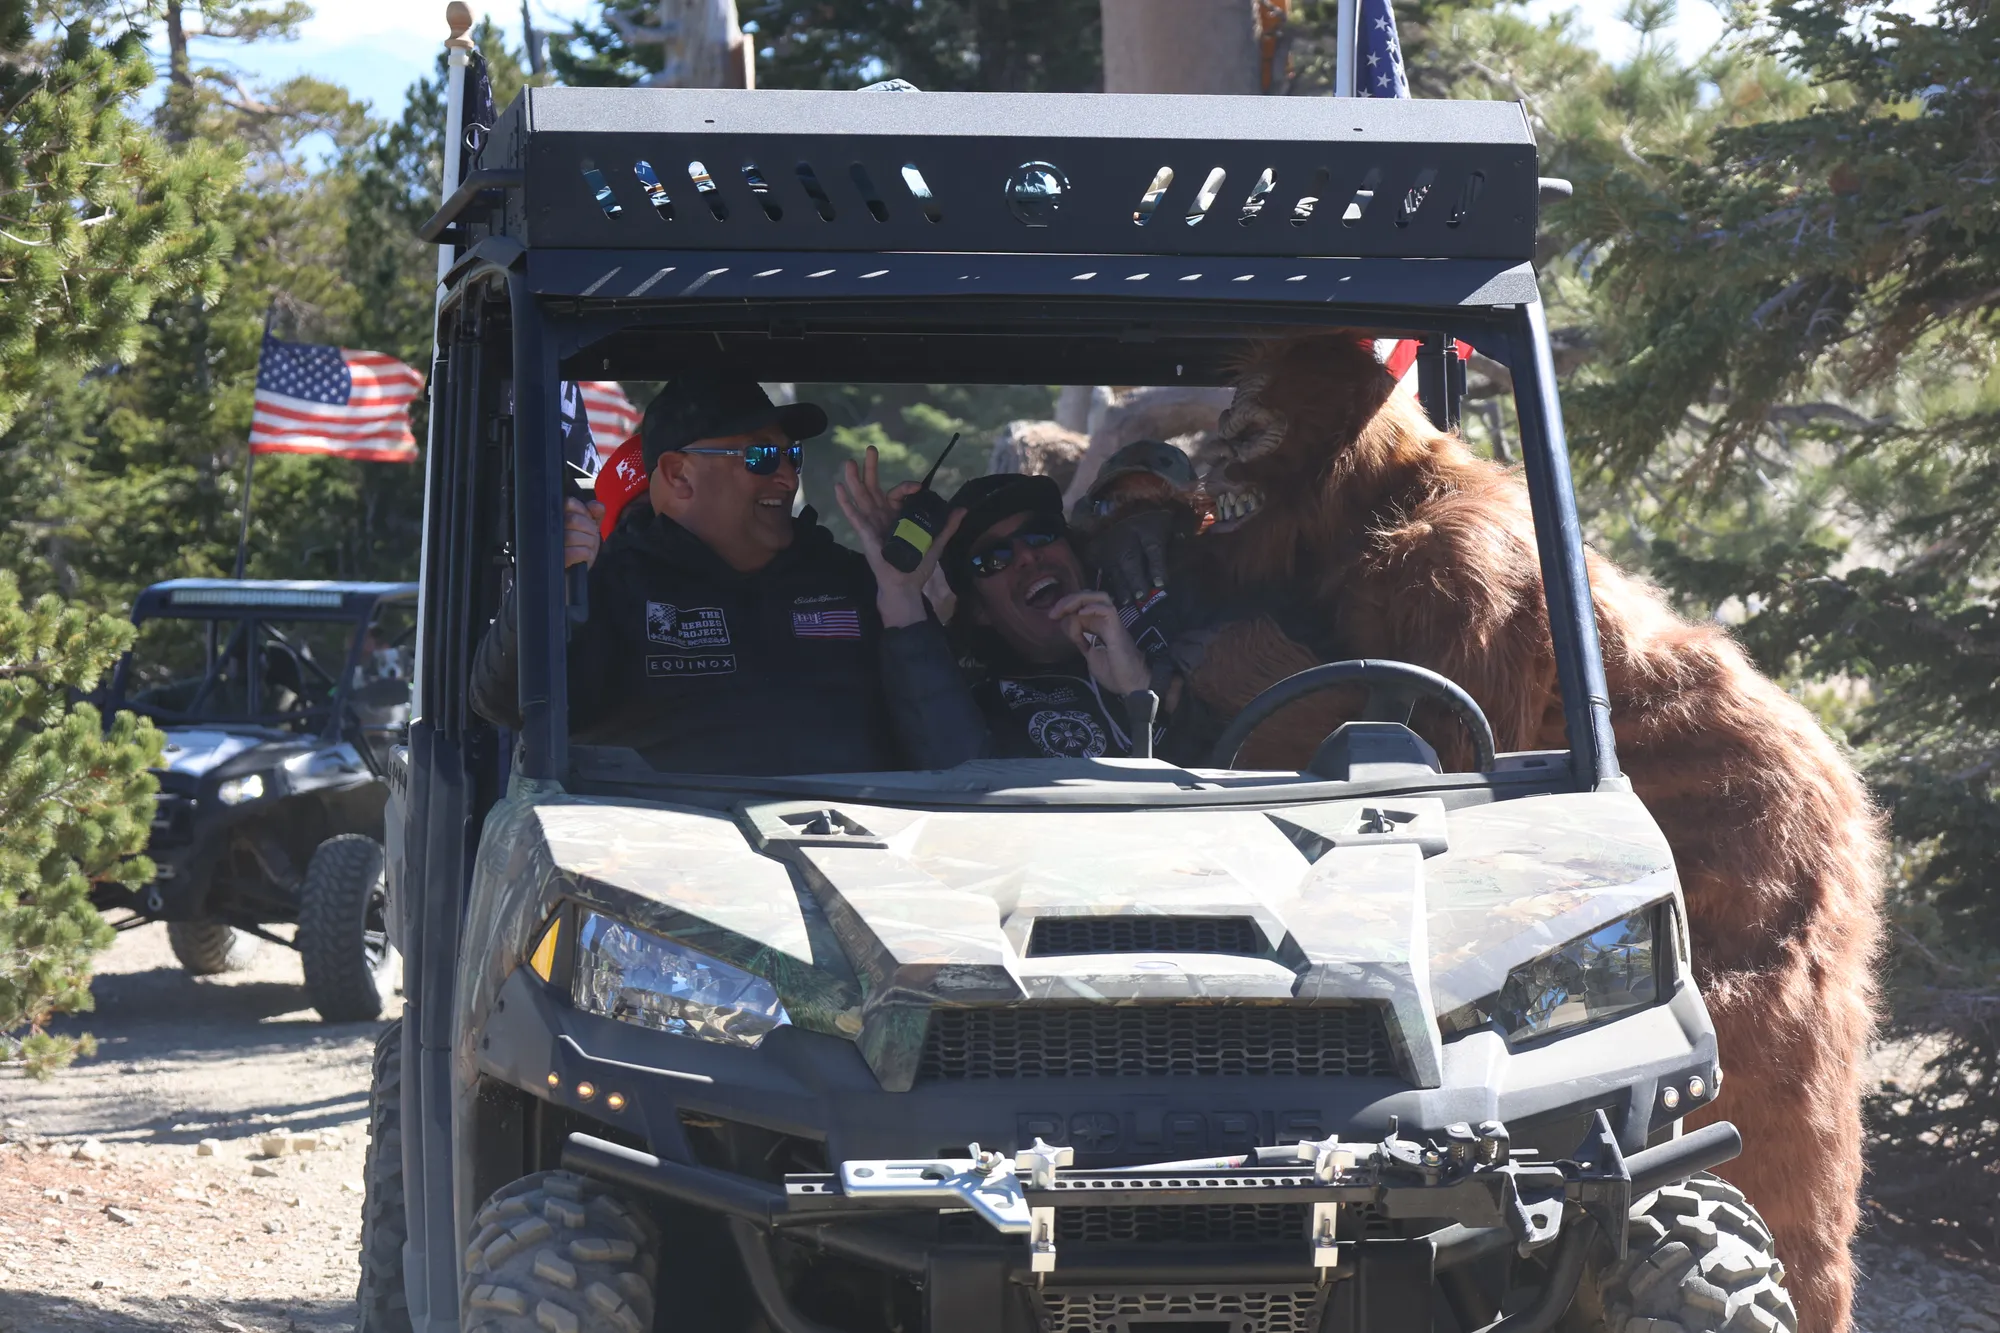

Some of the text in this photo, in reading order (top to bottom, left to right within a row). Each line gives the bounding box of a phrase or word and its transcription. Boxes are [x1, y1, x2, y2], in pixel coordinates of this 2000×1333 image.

[699, 611, 720, 619] THE
[681, 620, 722, 629] HEROES
[678, 628, 724, 639] PROJECT
[651, 658, 731, 671] EQUINOX
[1016, 1110, 1324, 1155] POLARIS
